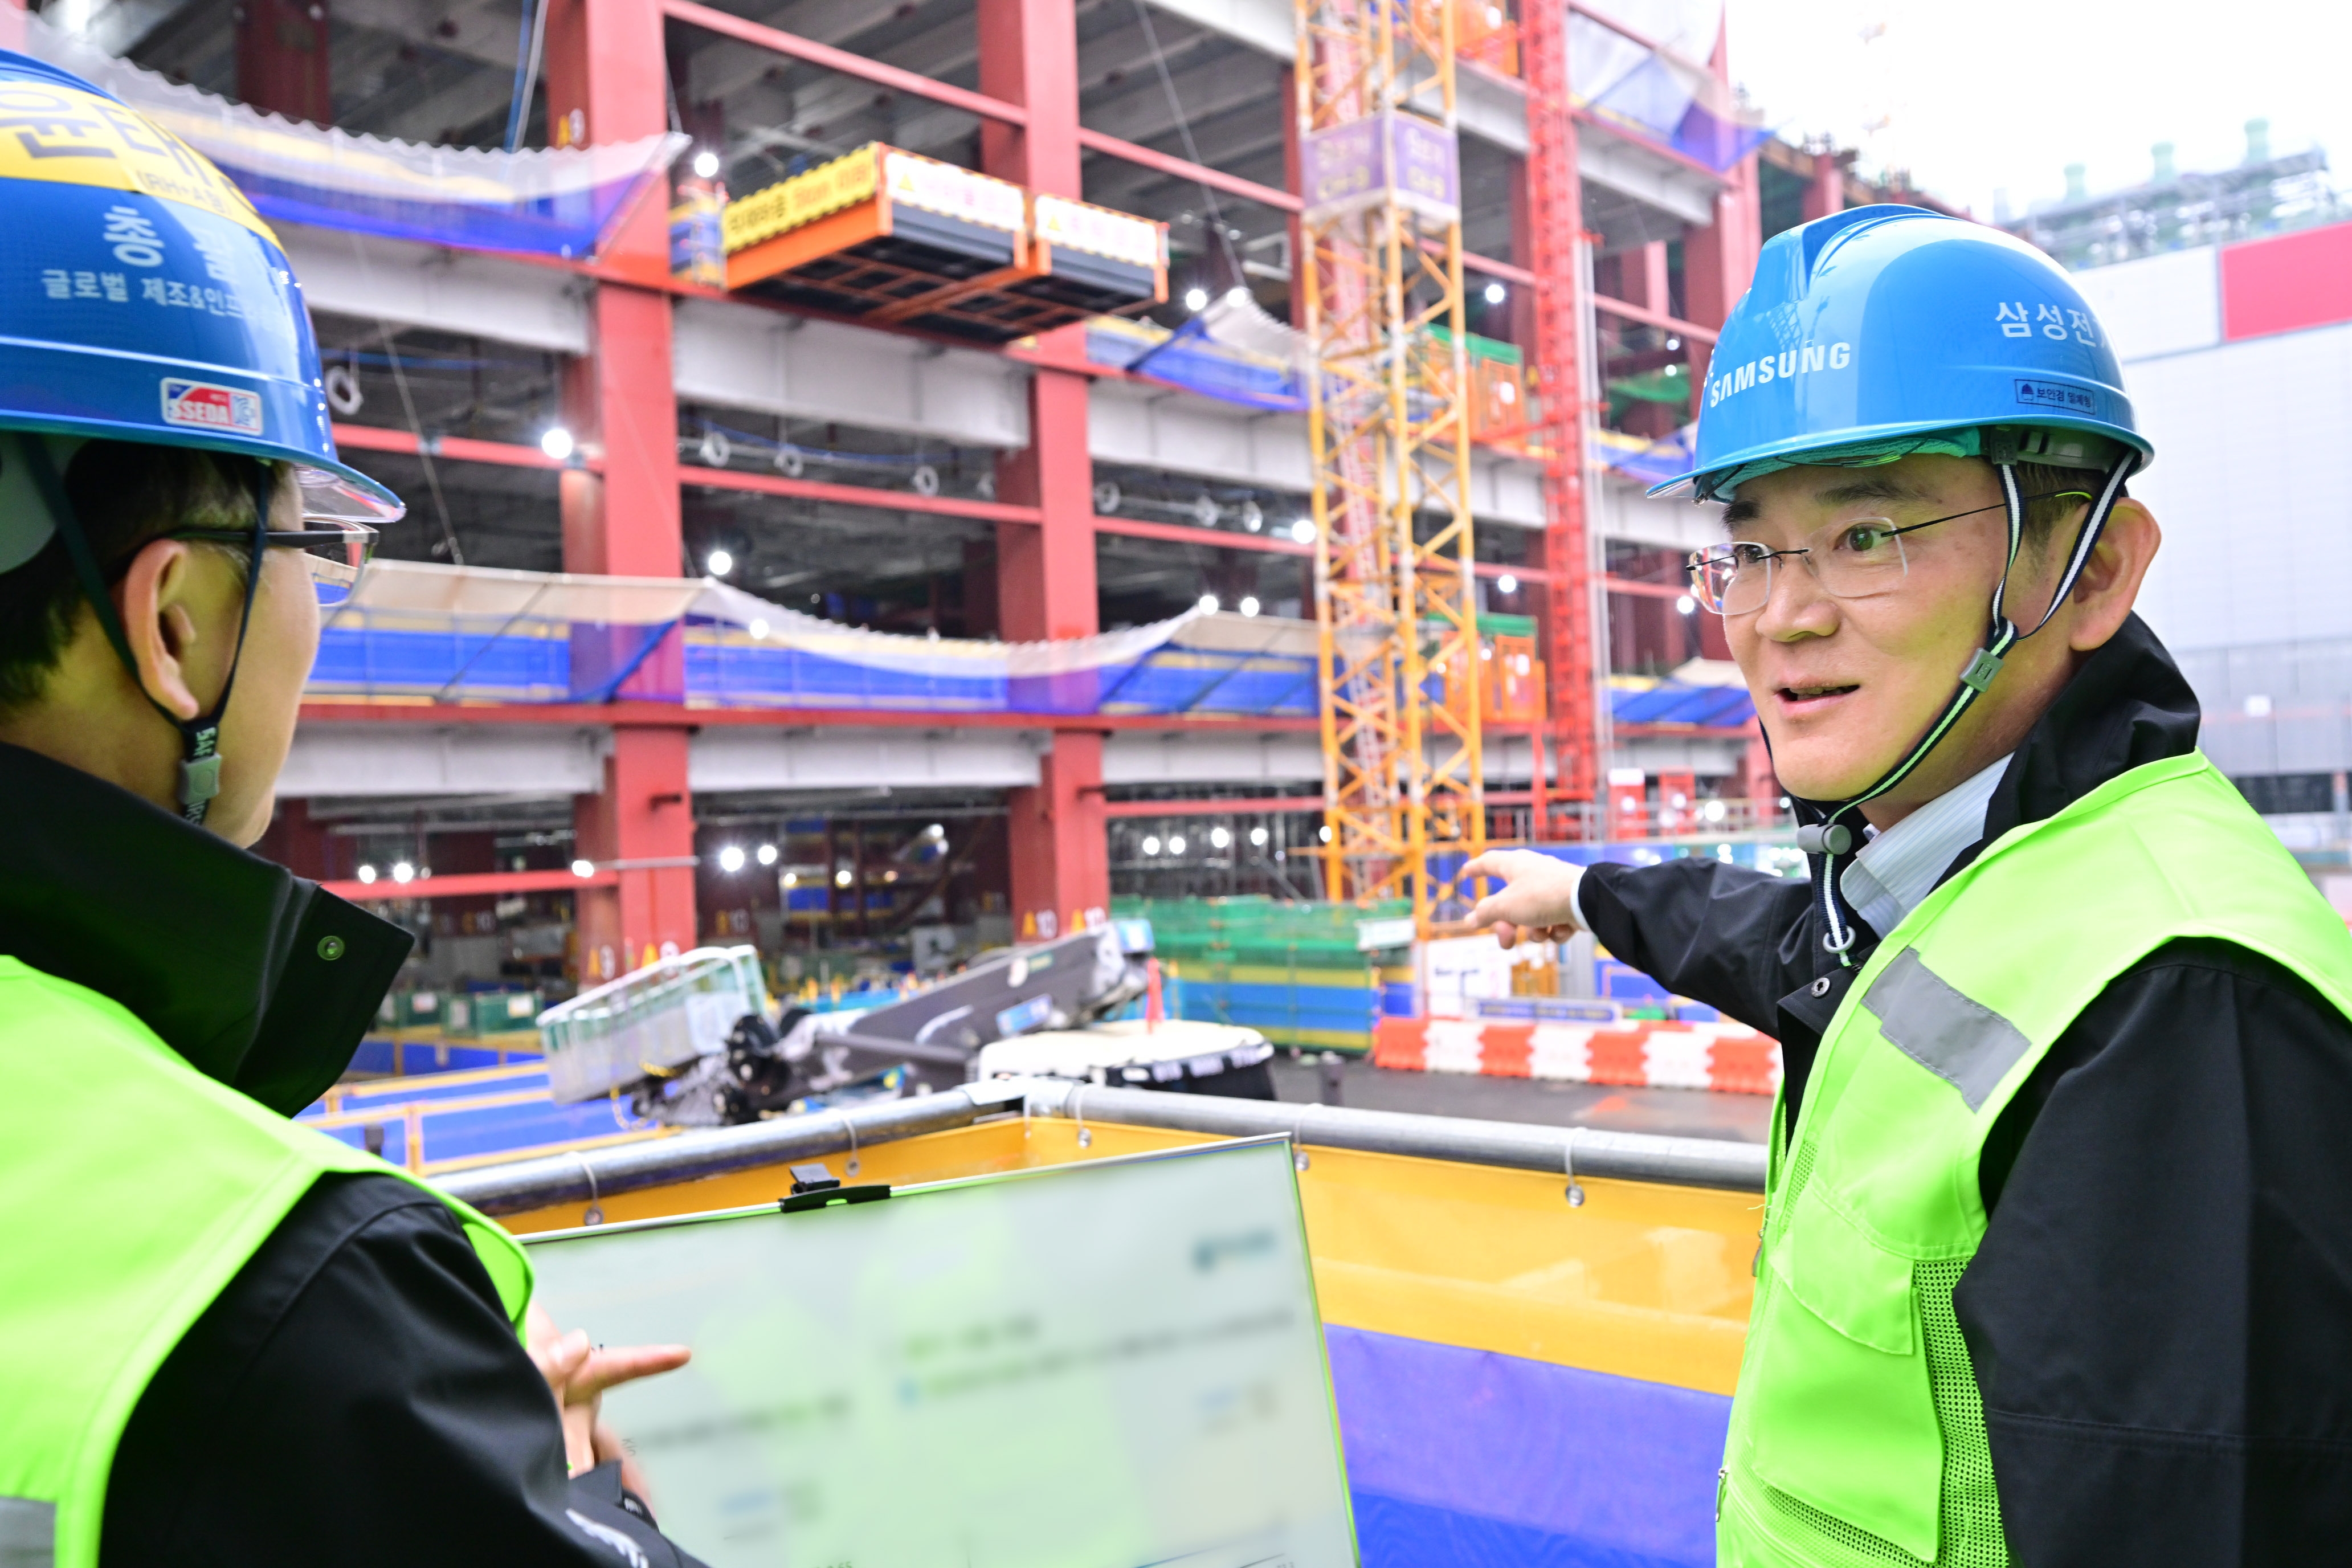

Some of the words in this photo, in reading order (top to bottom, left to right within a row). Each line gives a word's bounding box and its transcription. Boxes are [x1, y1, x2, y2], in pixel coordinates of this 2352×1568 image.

[0, 89, 259, 214] 윤태
[103, 206, 165, 268] 총
[42, 269, 128, 303] 글로벌
[1710, 342, 1851, 408] SAMSUNG
[2036, 387, 2065, 402] 보안경
